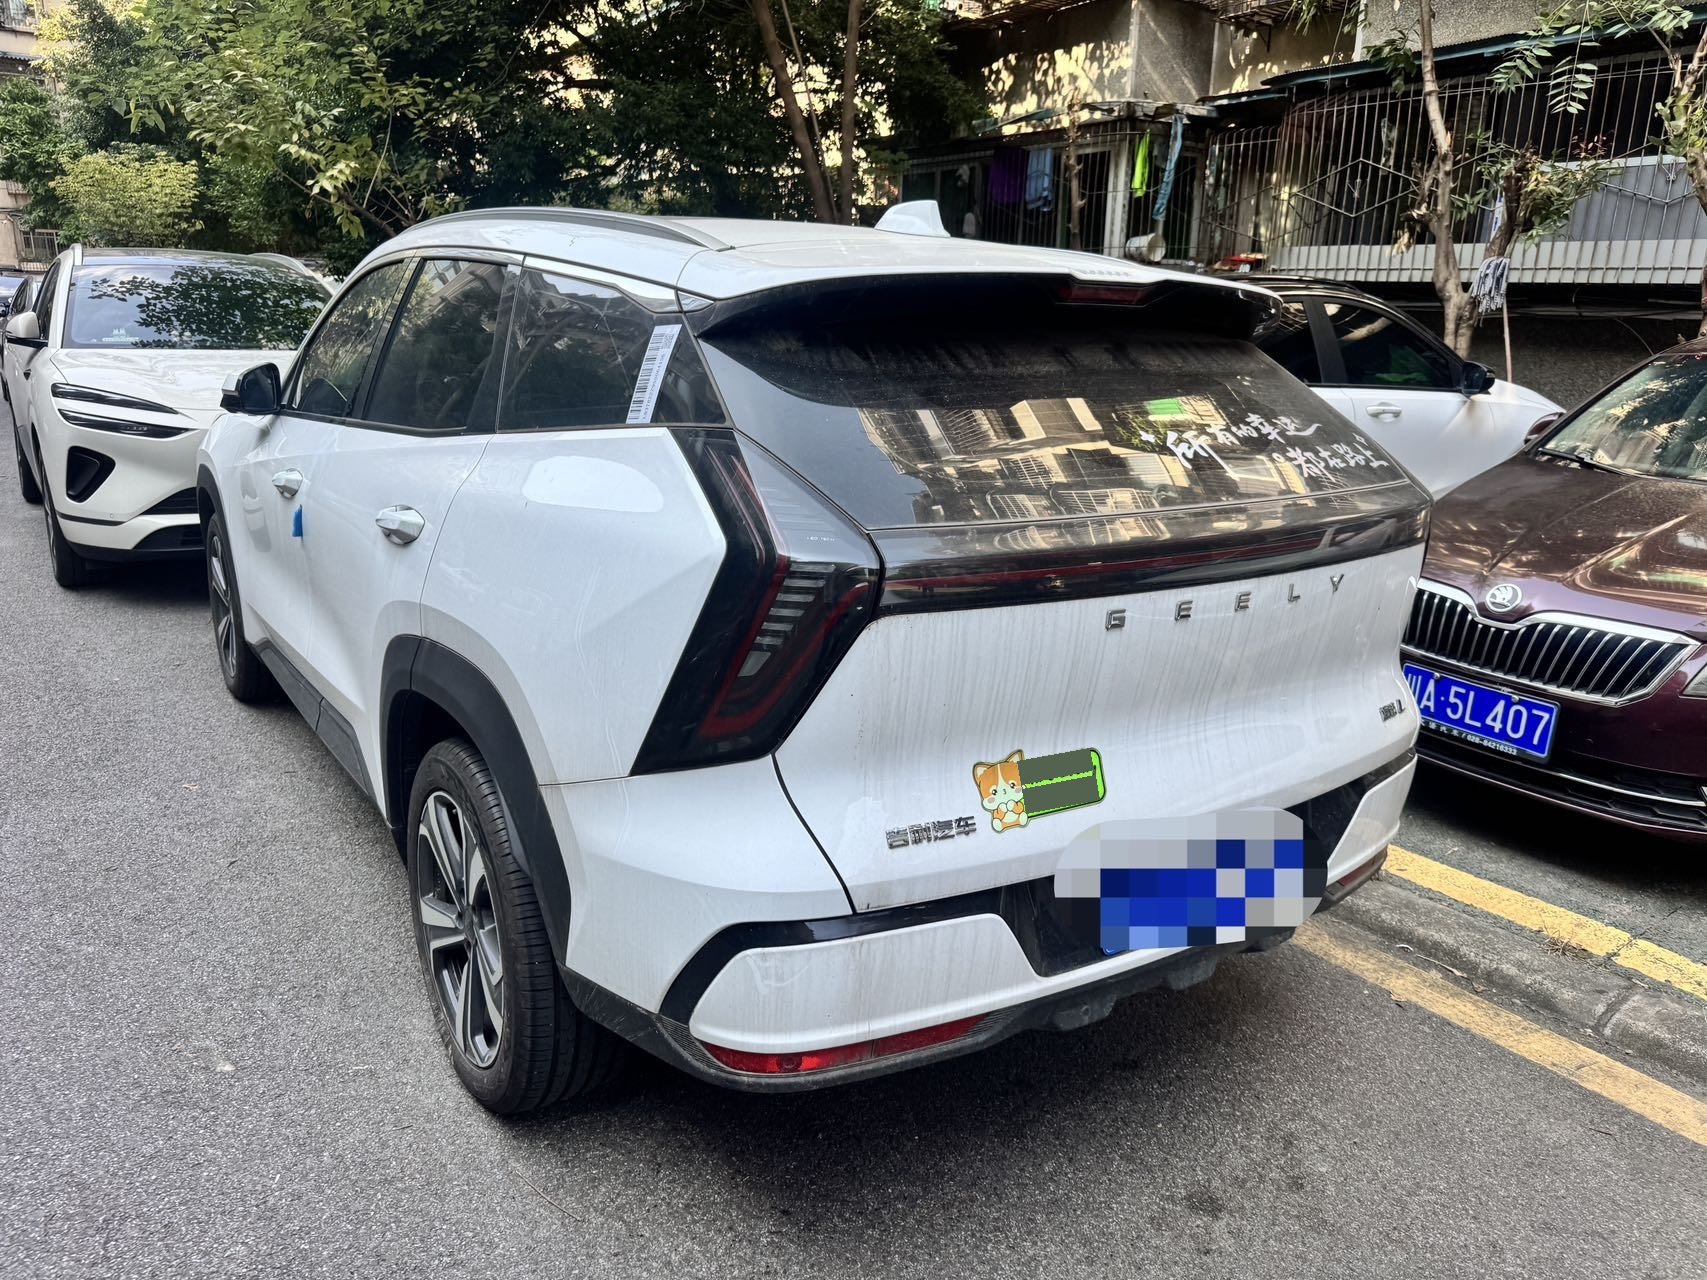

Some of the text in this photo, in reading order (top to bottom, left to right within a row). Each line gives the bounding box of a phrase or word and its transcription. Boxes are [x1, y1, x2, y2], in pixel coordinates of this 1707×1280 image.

[1167, 413, 1322, 481] 所有的幸运
[1286, 443, 1390, 482] 都在路上
[1104, 573, 1345, 631] GEELY
[886, 815, 977, 849] 吉利汽车
